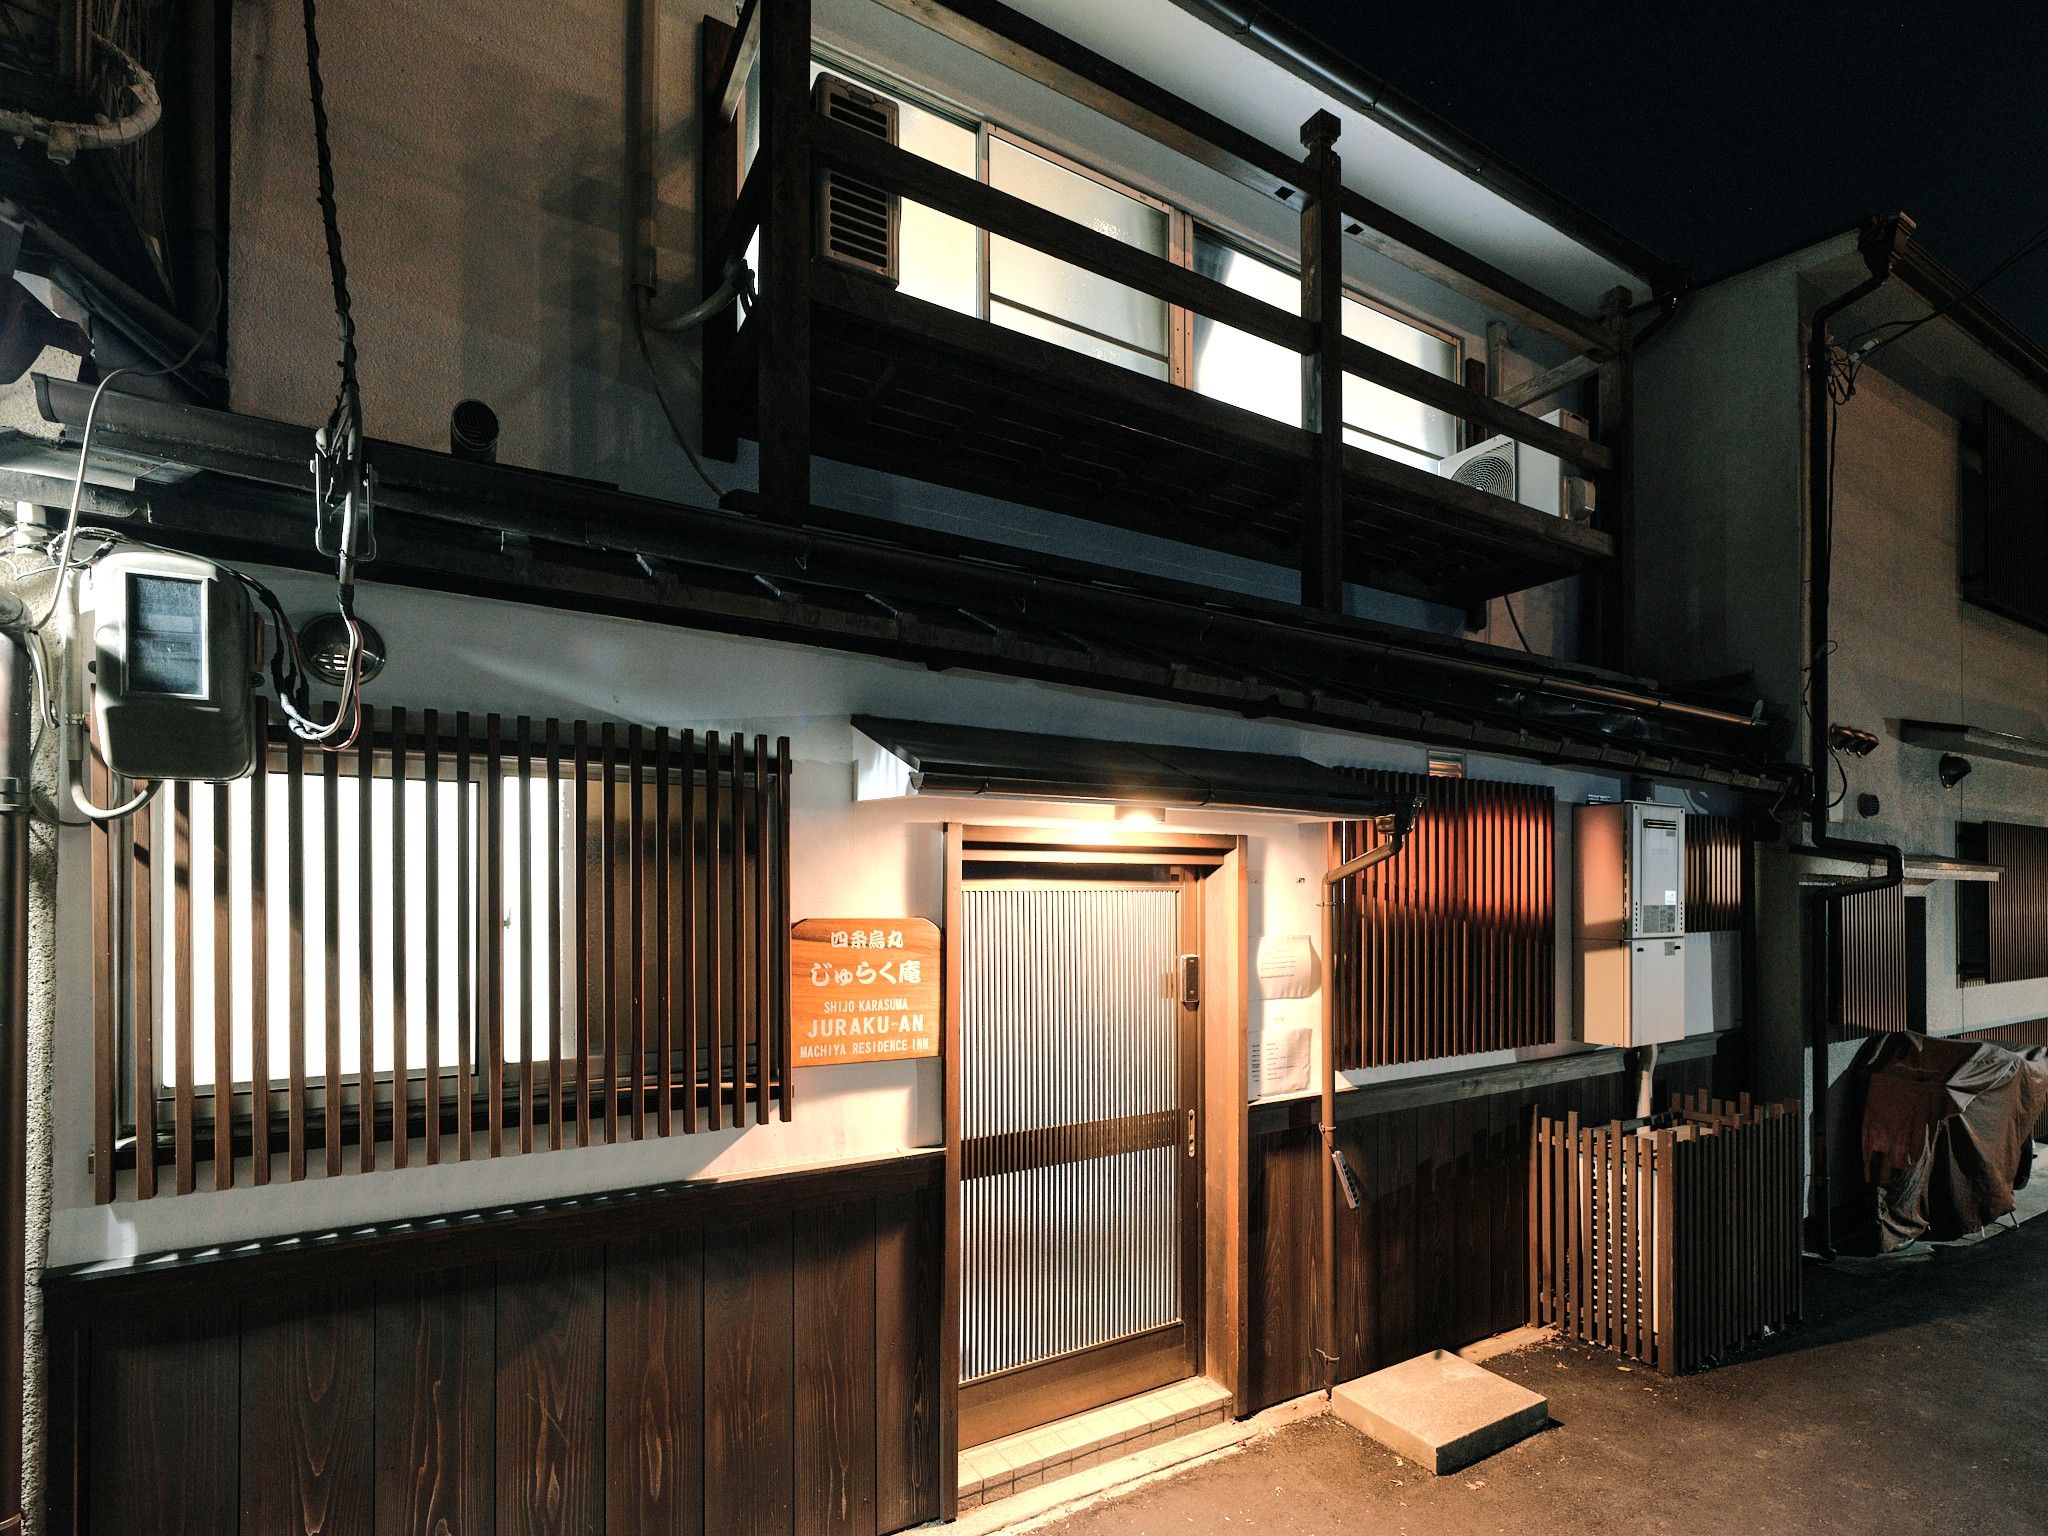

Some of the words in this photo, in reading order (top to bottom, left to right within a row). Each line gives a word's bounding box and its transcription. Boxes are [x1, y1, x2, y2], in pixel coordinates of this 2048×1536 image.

[831, 930, 904, 949] 四条烏丸
[811, 960, 922, 987] じゅらく庵
[824, 1000, 855, 1014] SHIJO
[858, 998, 908, 1013] KARASUMA
[807, 1014, 924, 1039] JURAKU-AN
[800, 1043, 847, 1059] MACHIYA
[852, 1039, 908, 1055] RESIDENCE
[912, 1038, 929, 1050] INN
